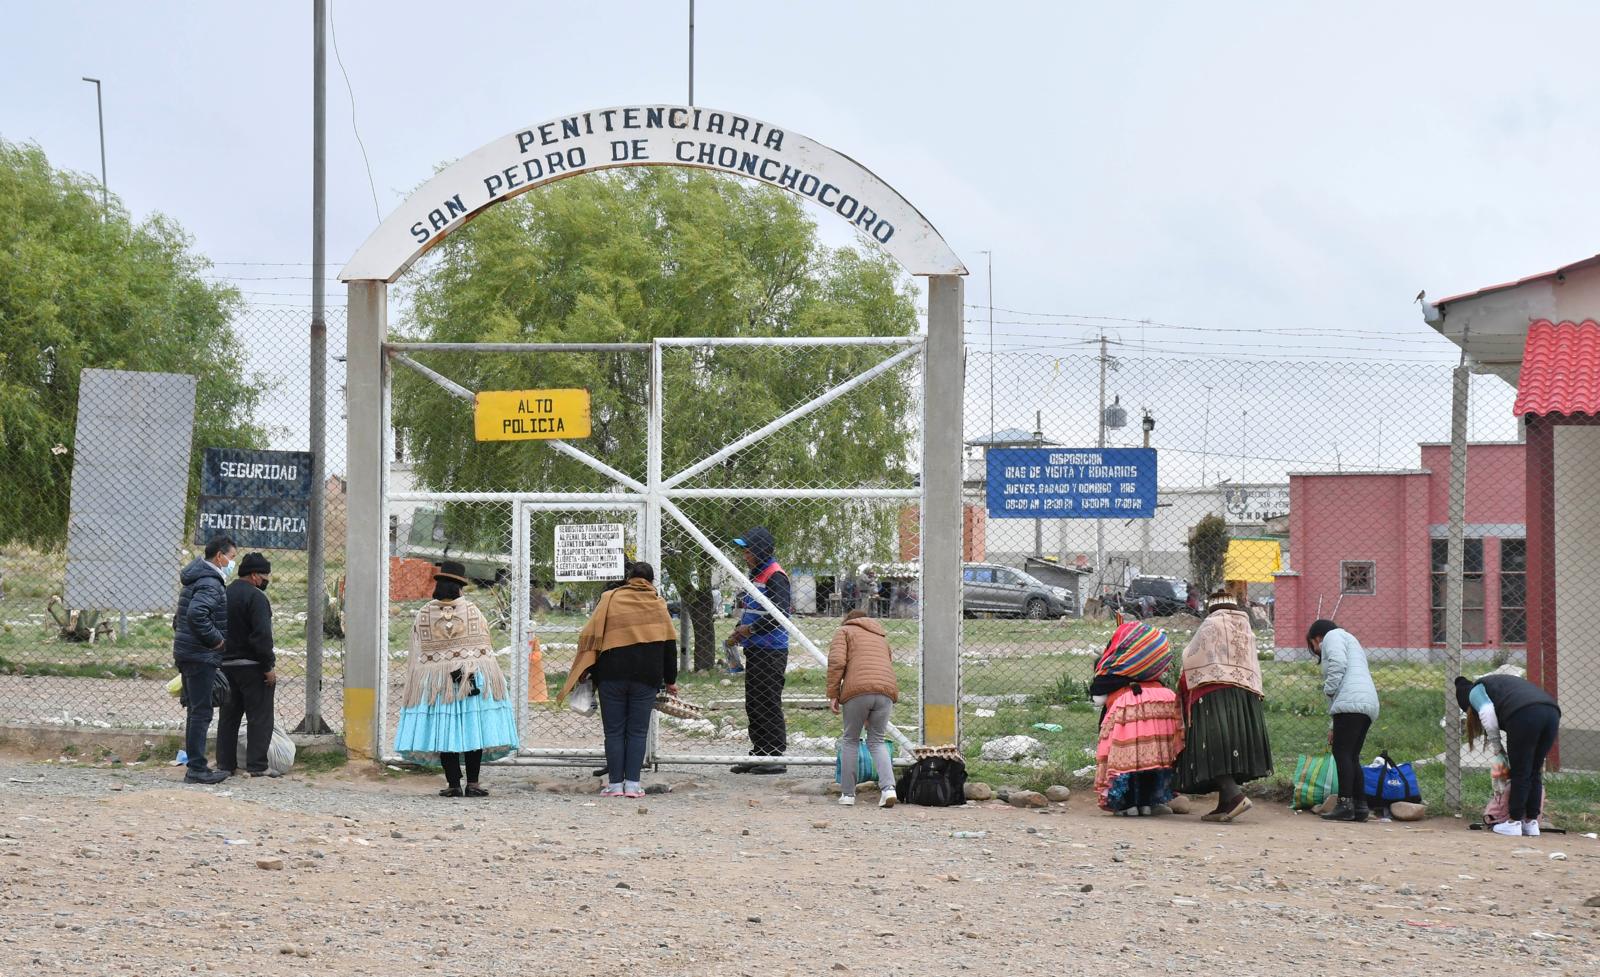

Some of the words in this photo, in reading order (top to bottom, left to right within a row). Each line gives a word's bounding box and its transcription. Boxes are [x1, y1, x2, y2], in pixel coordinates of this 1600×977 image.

[515, 107, 785, 152] PENITENCIARIA
[410, 194, 468, 244] SAN
[483, 146, 587, 199] PEDRO
[610, 139, 650, 162] DE
[675, 140, 895, 245] CHONCHOCORO
[518, 399, 553, 414] ALTO
[503, 417, 565, 434] POLICIA
[220, 461, 298, 481] SEGURIDAD
[1005, 466, 1026, 478] DIAS
[1029, 466, 1041, 478] DE
[1045, 466, 1075, 478] VISITA
[1079, 466, 1085, 478] Y
[1088, 466, 1138, 478] HORARIOS
[1072, 483, 1077, 493] Y
[199, 512, 307, 533] PENITENCIARIA
